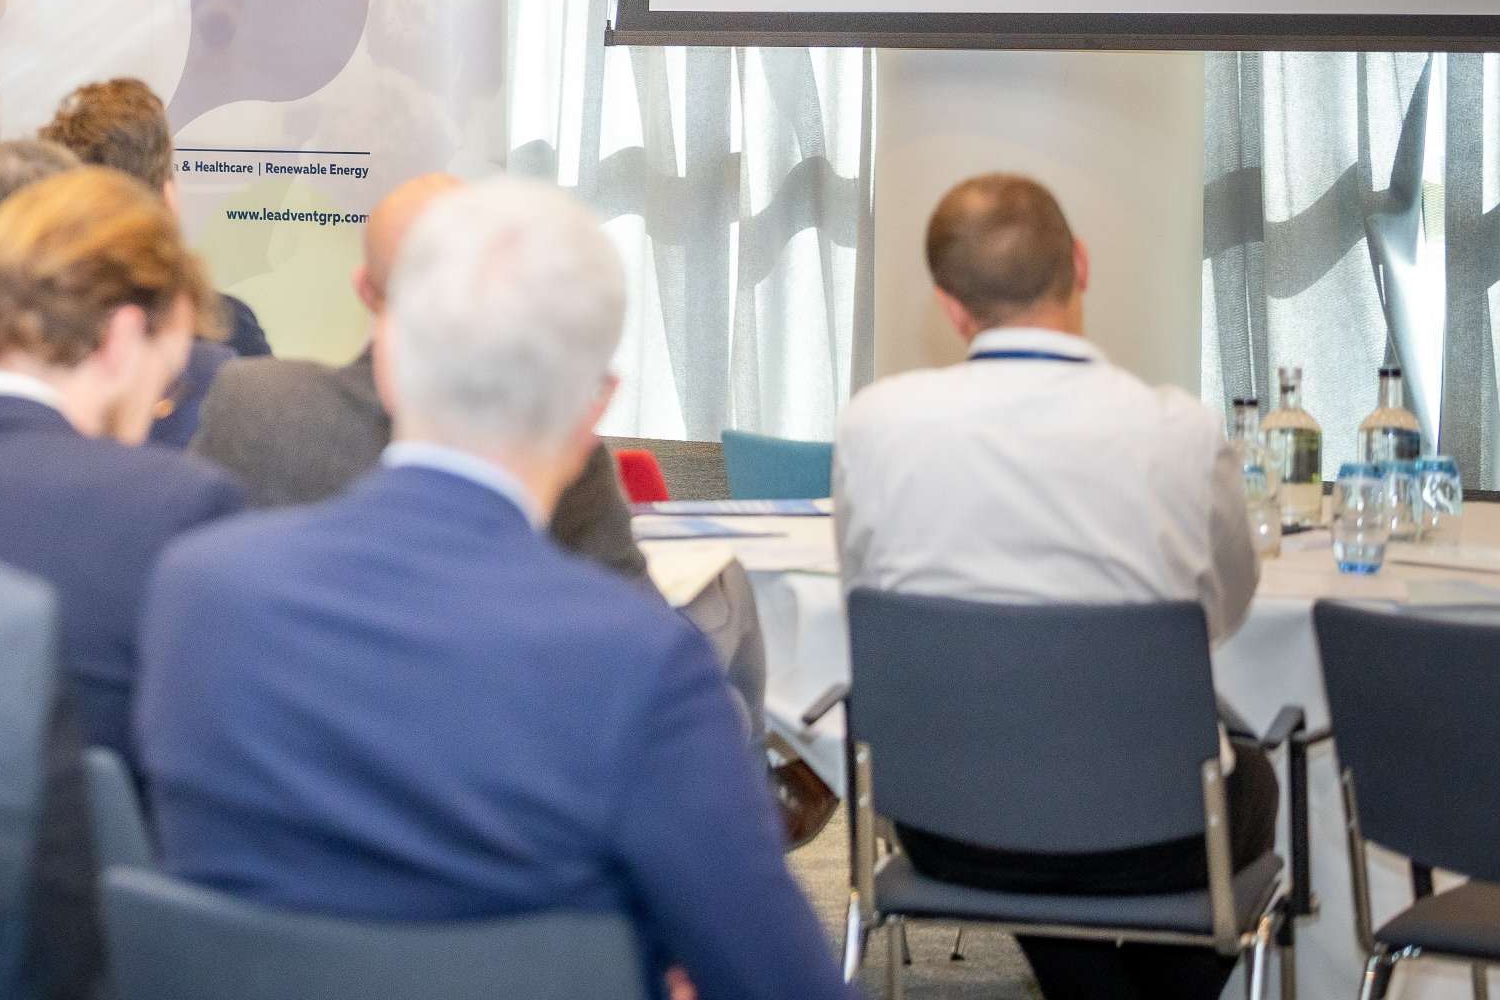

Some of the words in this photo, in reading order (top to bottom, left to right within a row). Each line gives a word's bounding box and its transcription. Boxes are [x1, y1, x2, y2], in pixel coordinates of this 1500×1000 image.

[195, 160, 253, 174] Healthcare
[265, 162, 327, 175] Renewable
[330, 164, 369, 179] Energy
